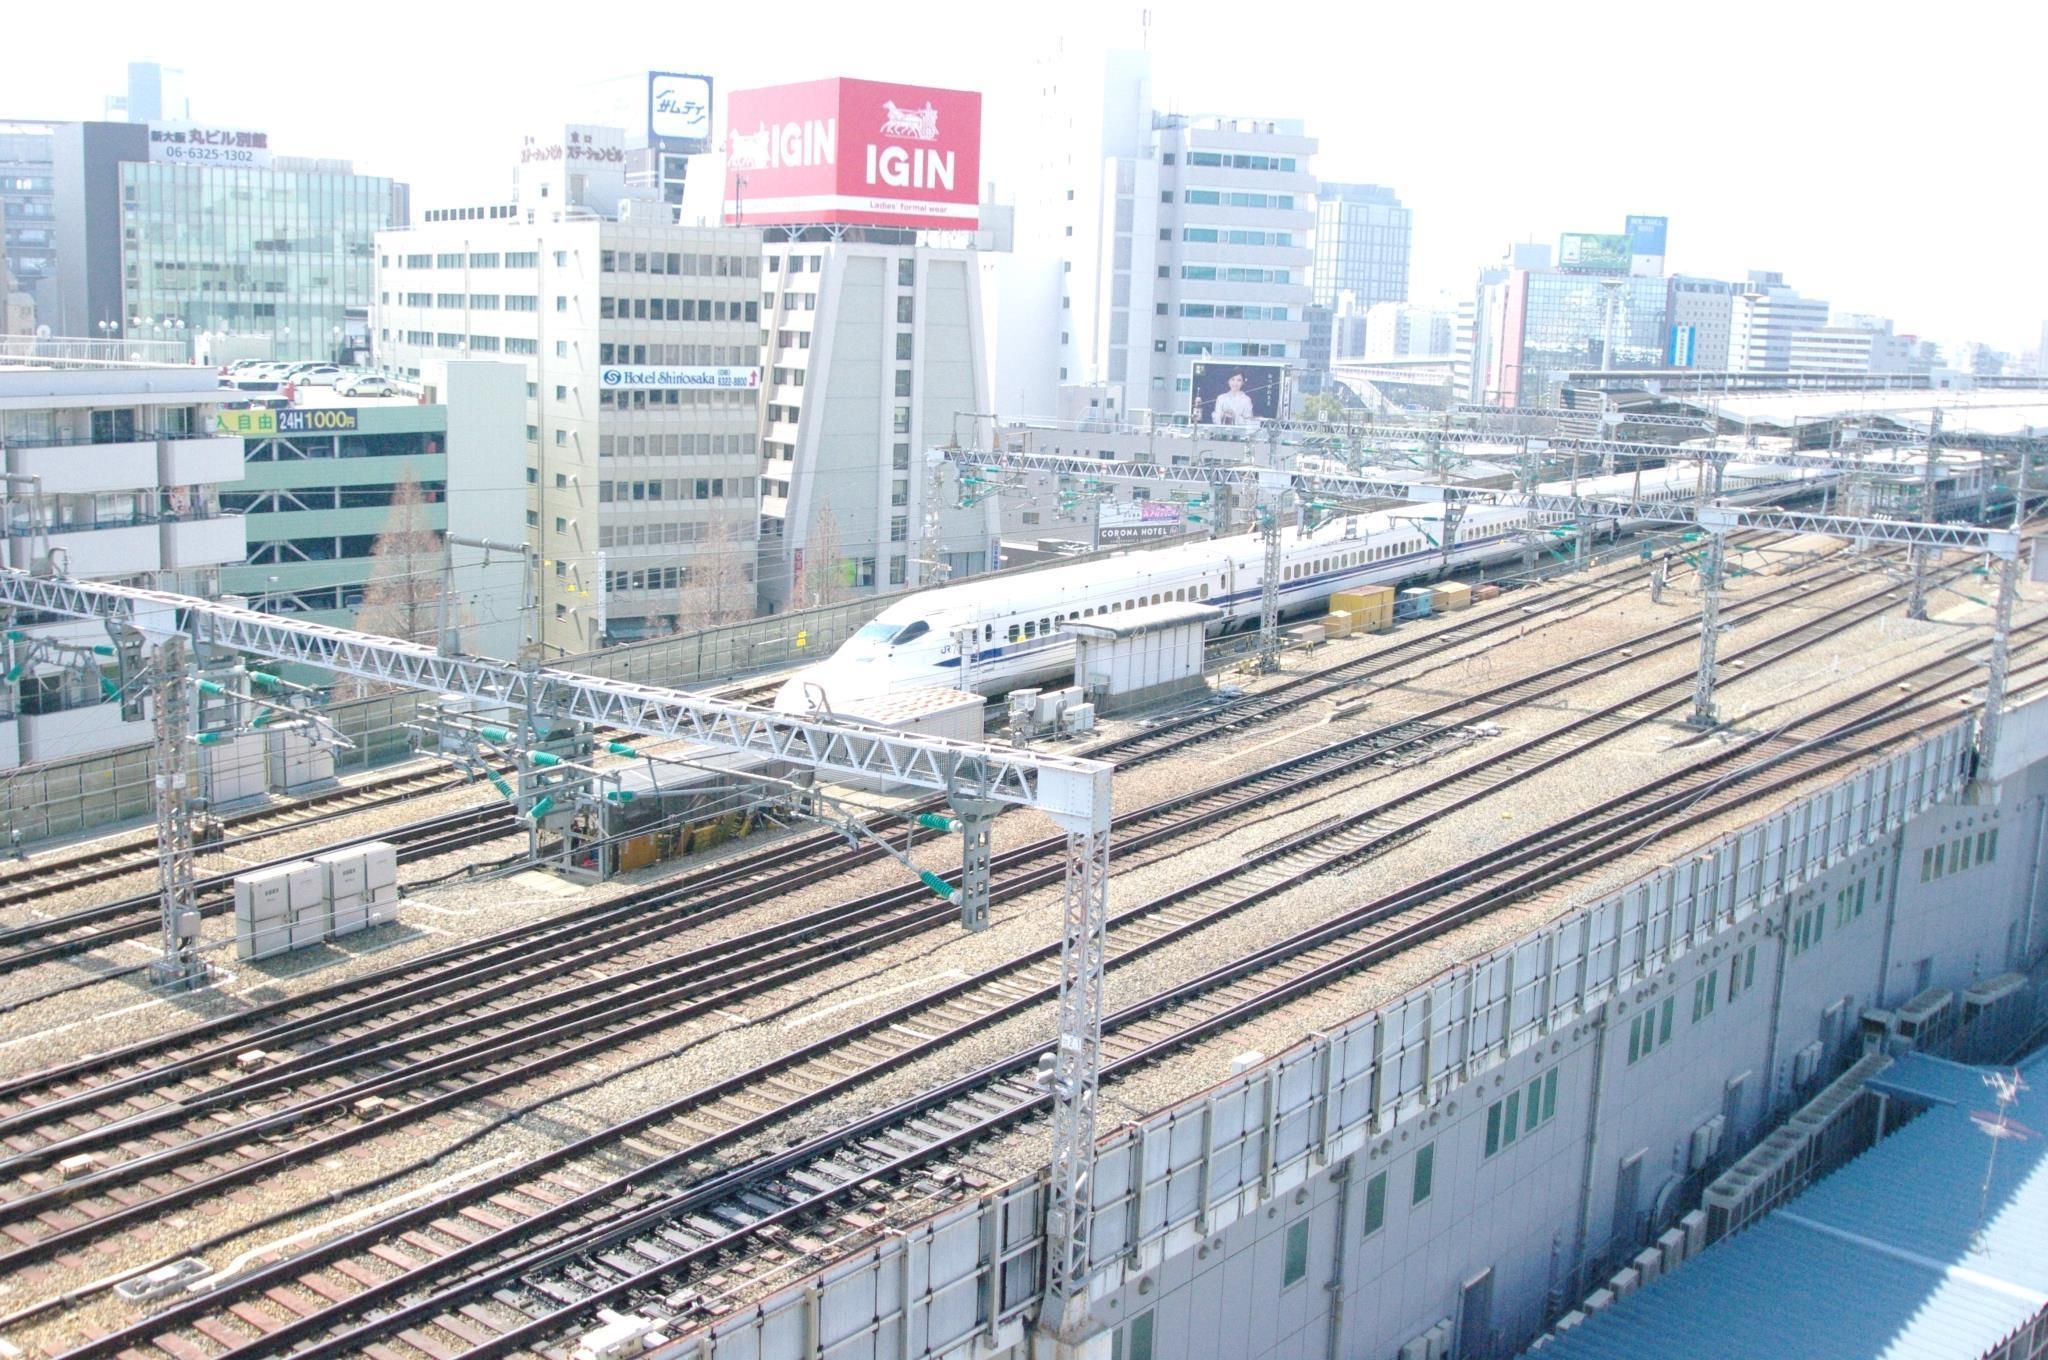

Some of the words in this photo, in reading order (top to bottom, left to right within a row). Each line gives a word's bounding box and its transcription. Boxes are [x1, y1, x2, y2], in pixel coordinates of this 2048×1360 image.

[188, 128, 268, 149] 丸ビル別館
[771, 118, 836, 168] IGIN
[166, 146, 253, 162] 06-6325-1302
[866, 144, 955, 191] IGIN
[870, 200, 898, 211] Ladies'
[900, 203, 927, 213] formal
[929, 206, 947, 214] wear
[624, 370, 655, 384] Hotel
[279, 411, 304, 430] 24H
[305, 410, 355, 429] 1000円
[1101, 528, 1138, 538] CORONA
[1141, 527, 1167, 536] HOTEL
